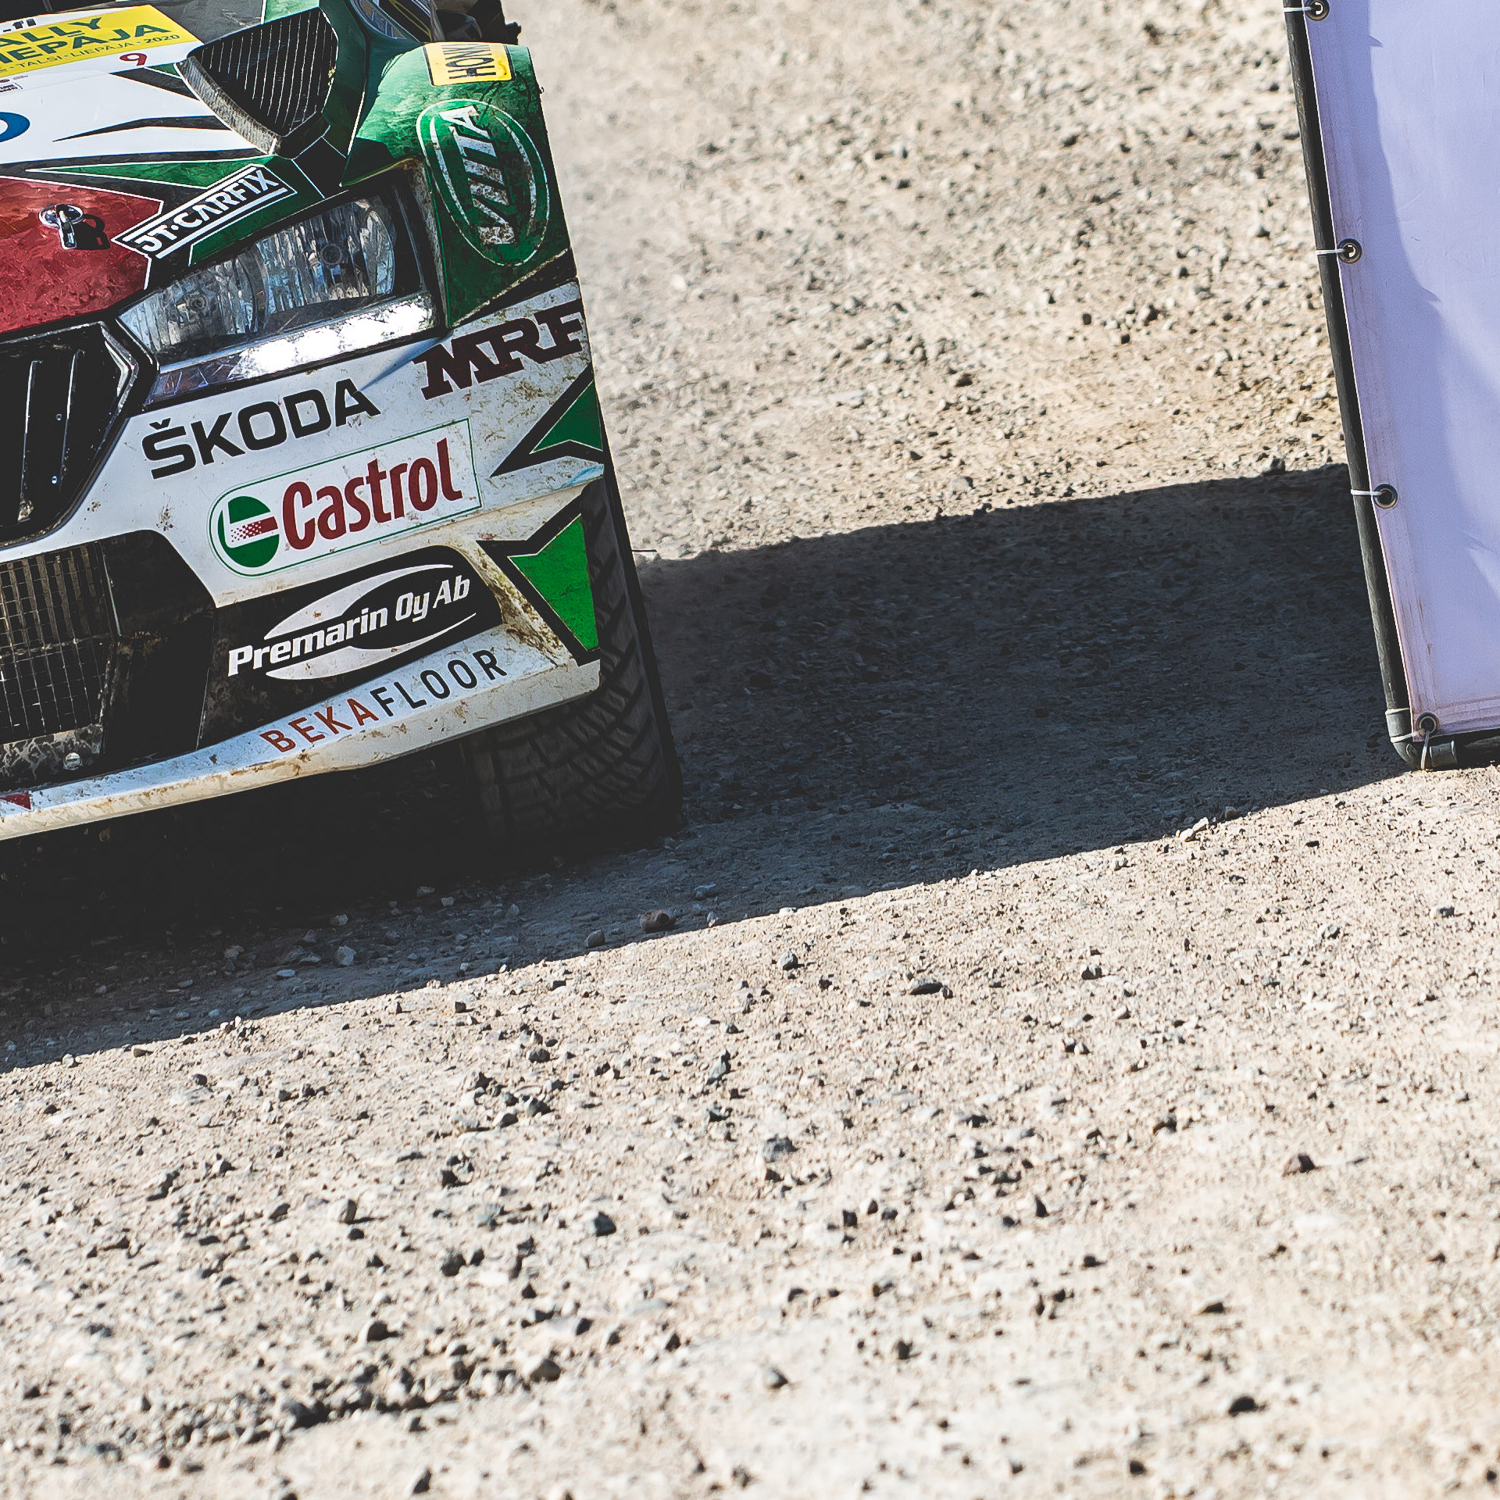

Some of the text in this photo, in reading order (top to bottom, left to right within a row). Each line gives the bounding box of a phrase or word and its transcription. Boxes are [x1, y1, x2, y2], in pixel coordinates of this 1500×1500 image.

[17, 55, 63, 70] TALSI
[144, 33, 182, 45] 2020
[438, 105, 518, 247] VIITA
[412, 299, 587, 401] MRF
[141, 378, 381, 480] ŠKODA
[281, 436, 464, 552] Castrol
[227, 574, 472, 677] Premarin Oy Ab
[260, 649, 508, 753] BEKAFLOOR
